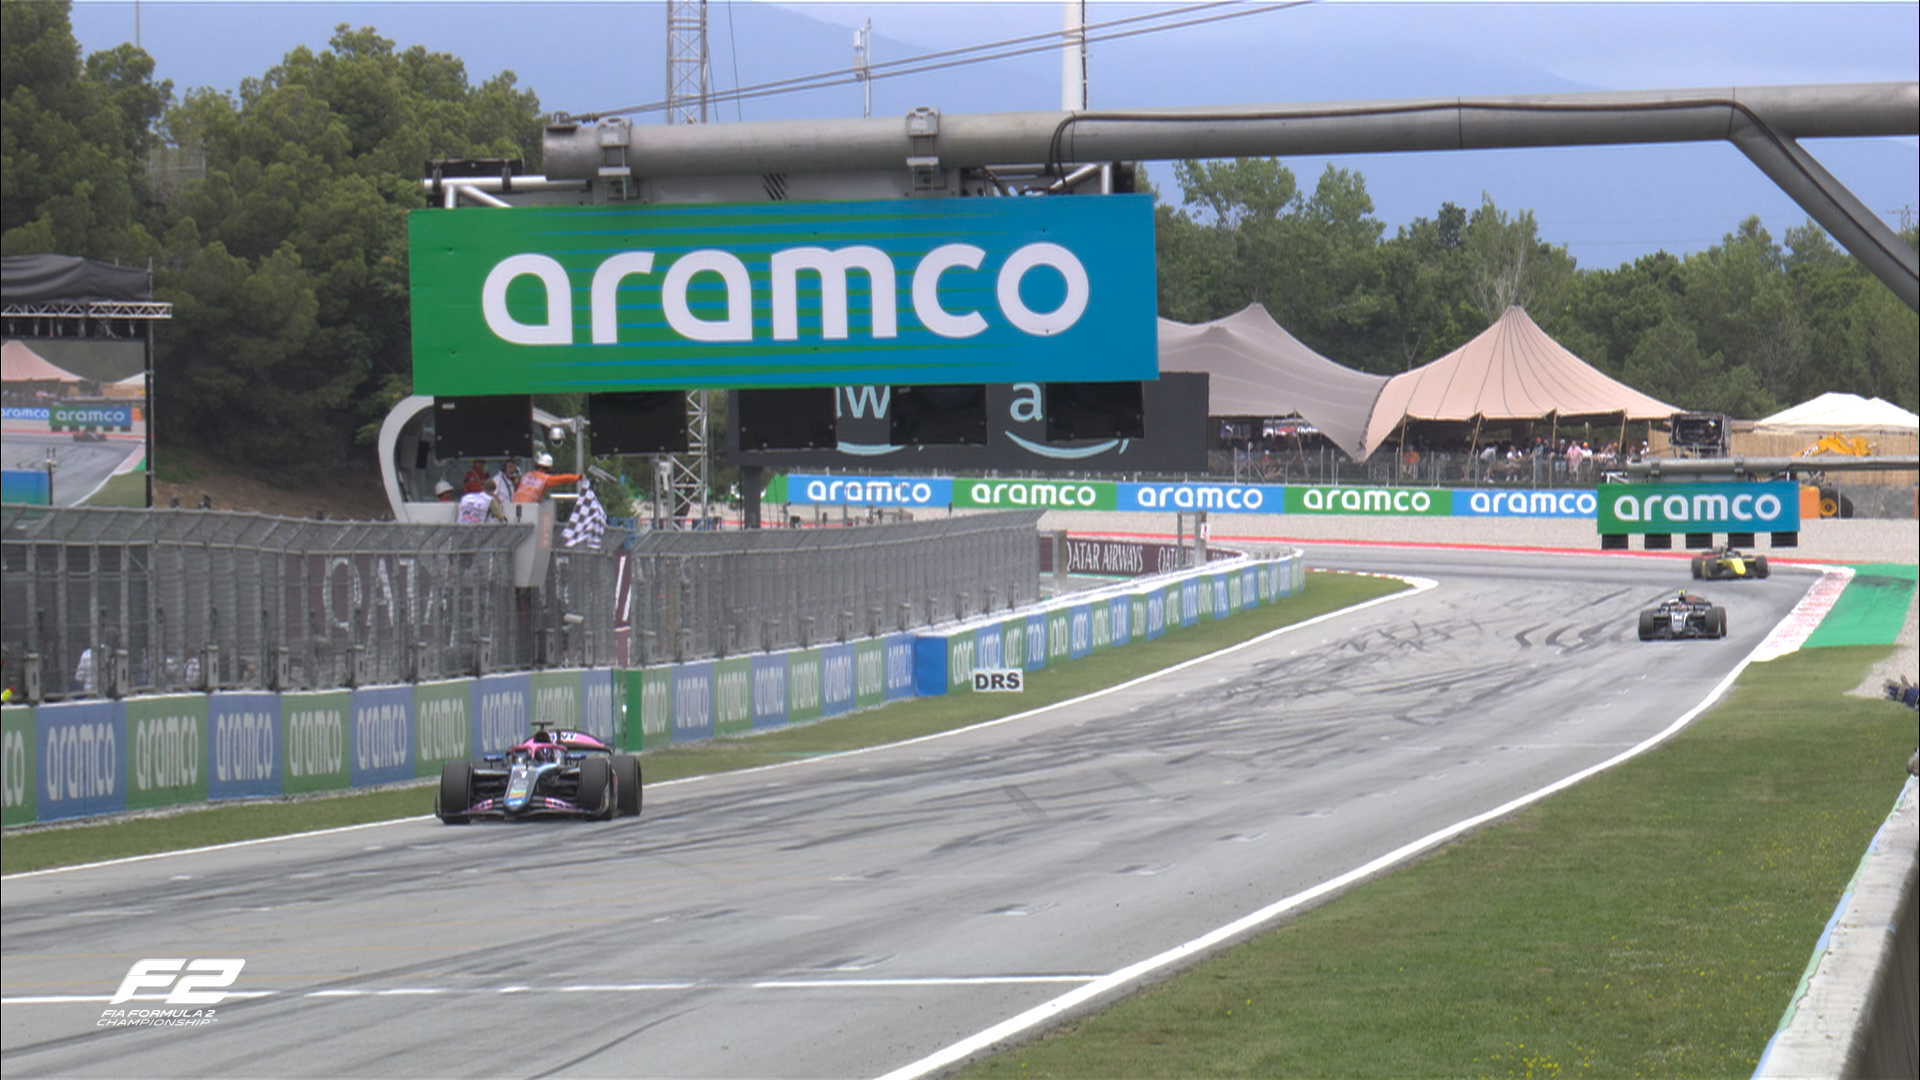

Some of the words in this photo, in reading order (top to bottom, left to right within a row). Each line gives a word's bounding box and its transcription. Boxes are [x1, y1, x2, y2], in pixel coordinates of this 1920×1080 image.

[482, 242, 1090, 345] aramco
[56, 409, 125, 422] aramco
[807, 480, 932, 503] aramco
[971, 482, 1096, 506] aramco
[1137, 485, 1263, 510] aramco
[1303, 488, 1431, 512] aramco
[1470, 490, 1597, 514] aramco
[1614, 493, 1782, 521] aramco
[1102, 543, 1143, 573] AIRWAYS
[975, 672, 1020, 690] DRS
[420, 698, 465, 761] aramco
[481, 690, 525, 754] aramco
[216, 712, 273, 782] aramco
[289, 709, 342, 778] aramco
[357, 704, 406, 771] aramco
[47, 722, 116, 801] aramco
[136, 715, 198, 791] aramco
